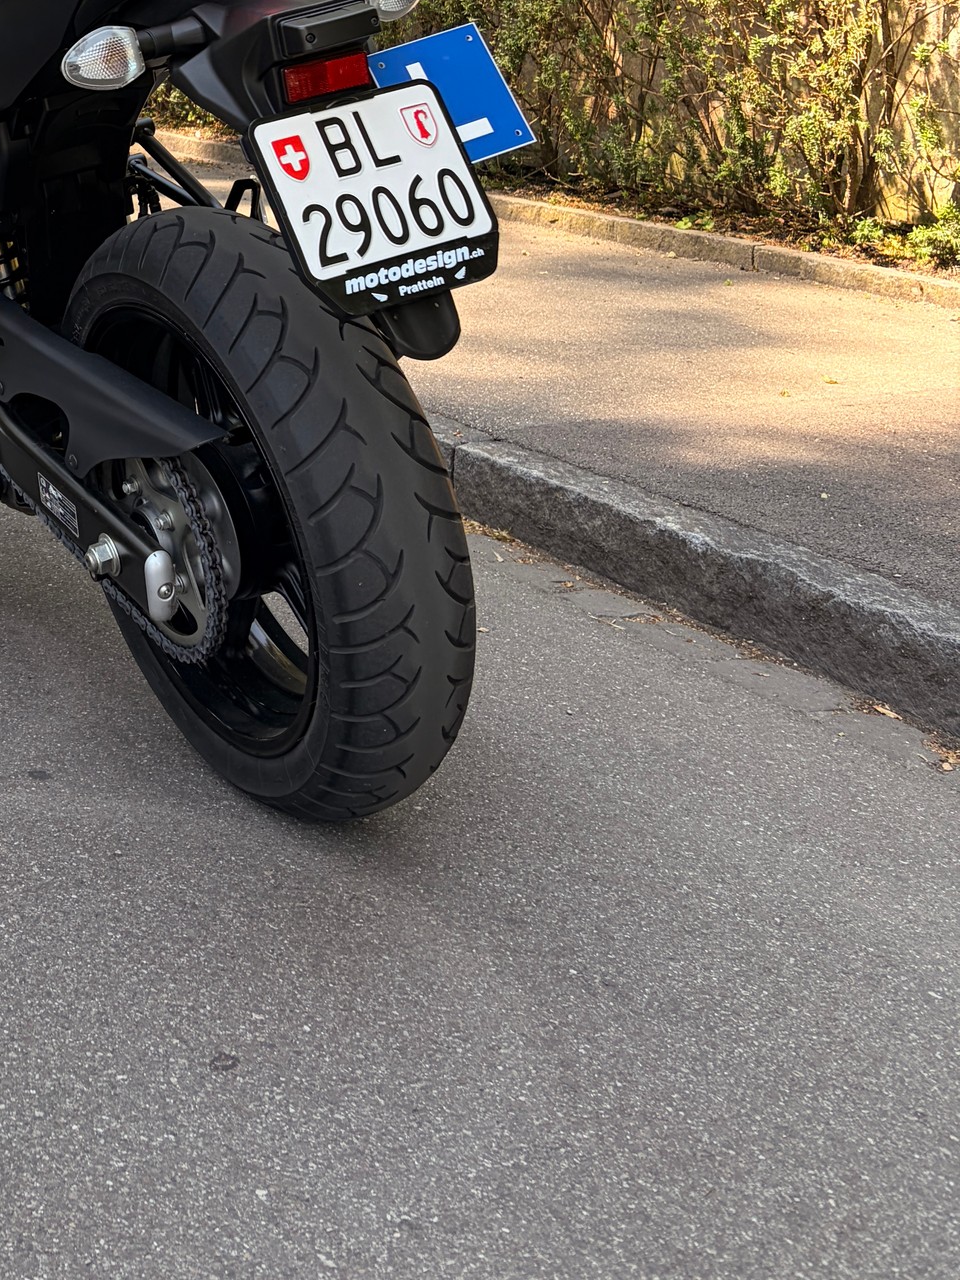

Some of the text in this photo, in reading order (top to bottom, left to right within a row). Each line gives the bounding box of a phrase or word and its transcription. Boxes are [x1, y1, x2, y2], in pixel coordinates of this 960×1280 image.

[315, 111, 402, 178] BL
[302, 168, 475, 268] 29060
[345, 246, 484, 295] motodesign.ch
[398, 276, 445, 296] Pratteln
